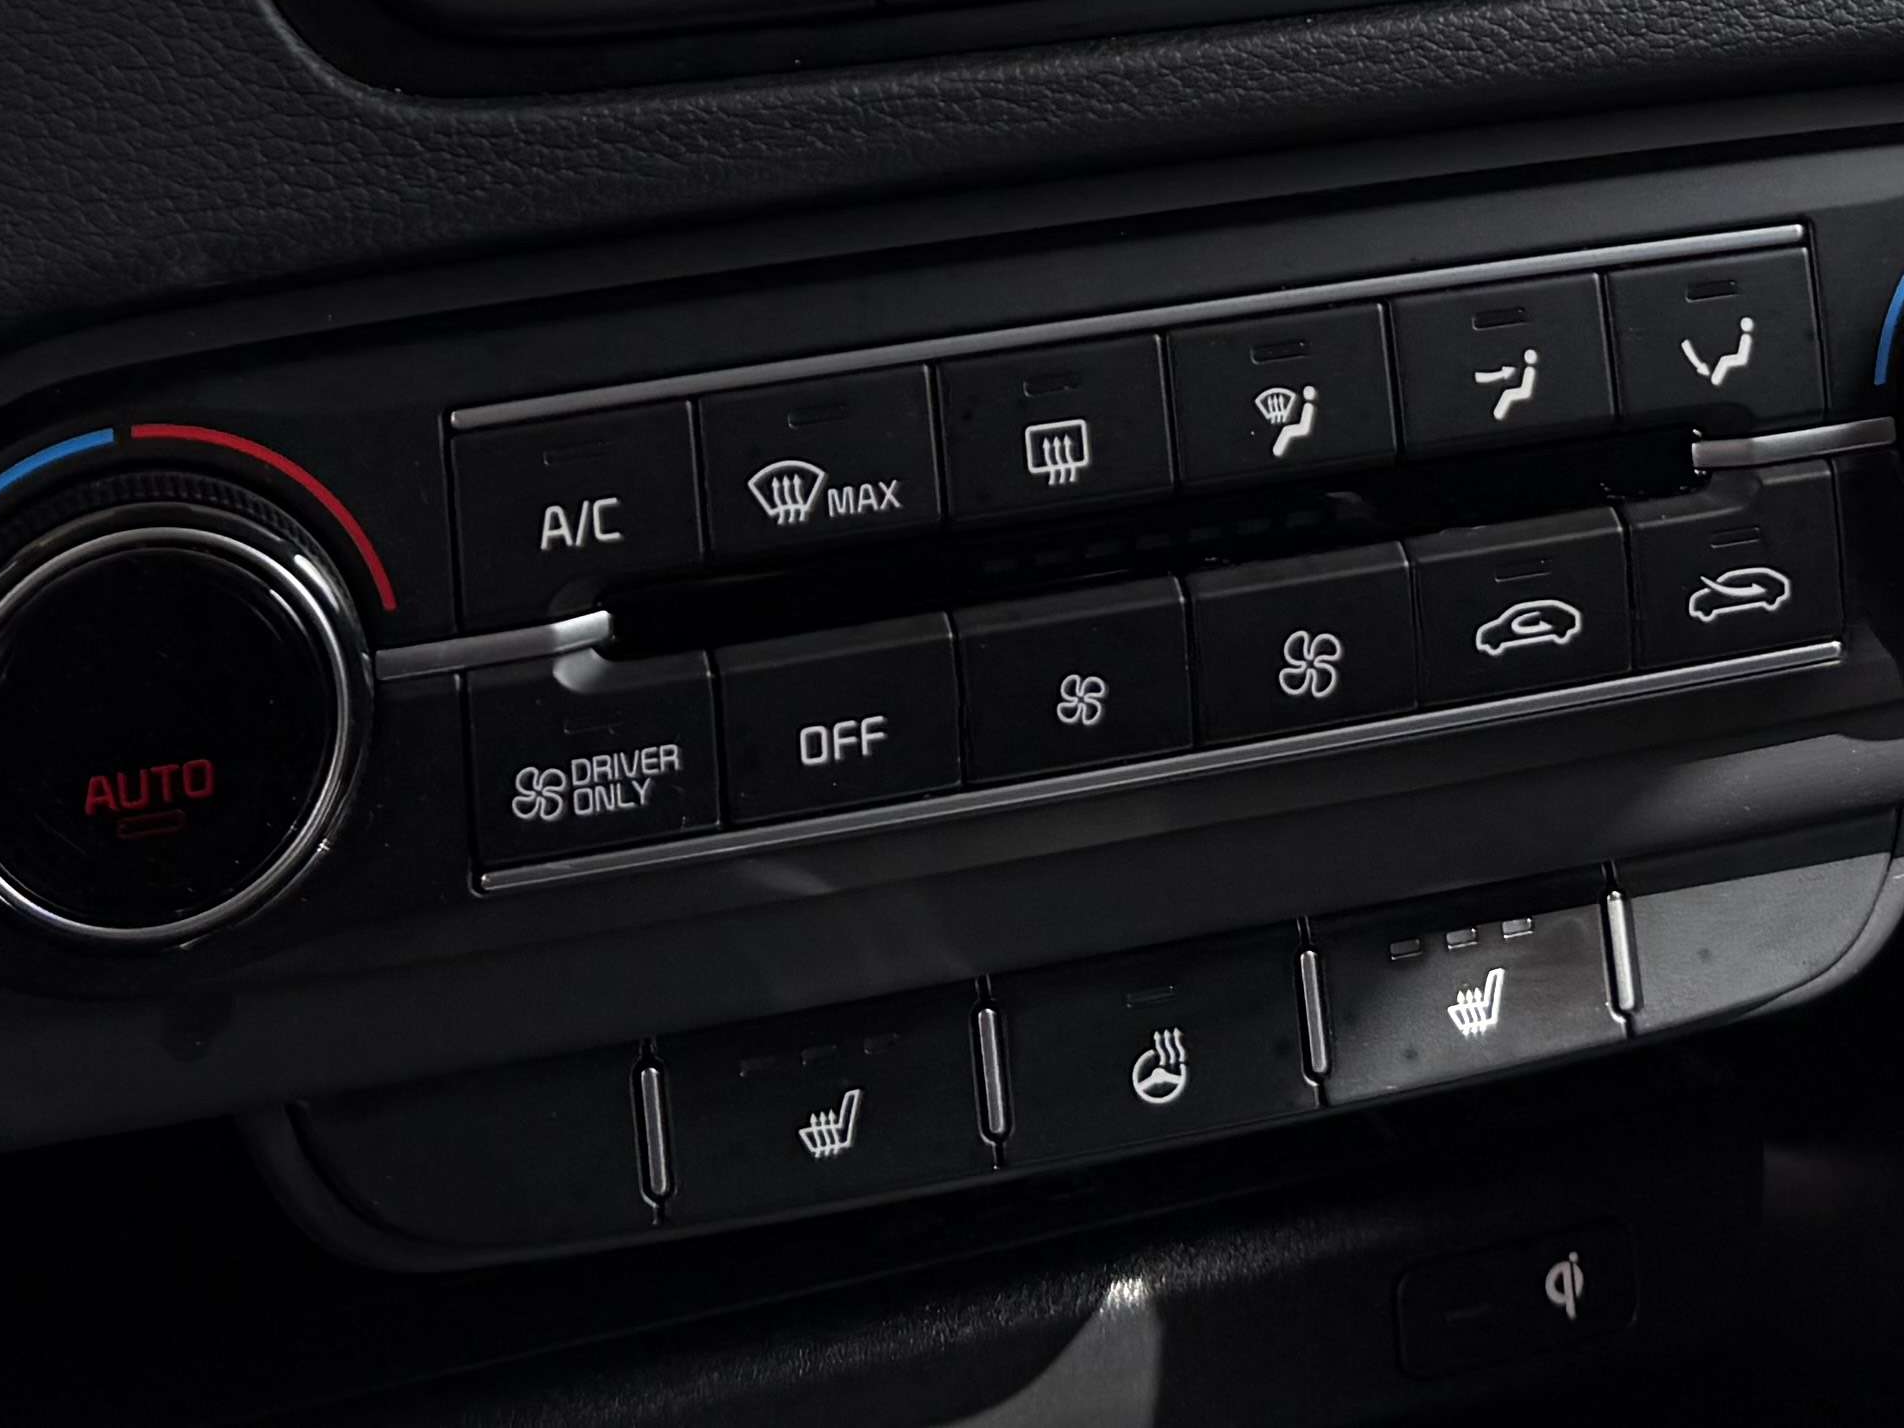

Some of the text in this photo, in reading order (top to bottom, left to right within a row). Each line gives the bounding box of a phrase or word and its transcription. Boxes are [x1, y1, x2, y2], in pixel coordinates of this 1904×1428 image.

[827, 480, 903, 518] MAX
[540, 497, 622, 551] A/C
[799, 715, 888, 766] OFF
[83, 757, 216, 816] AUTO
[570, 744, 682, 786] DRIVER
[573, 779, 656, 817] ONLY
